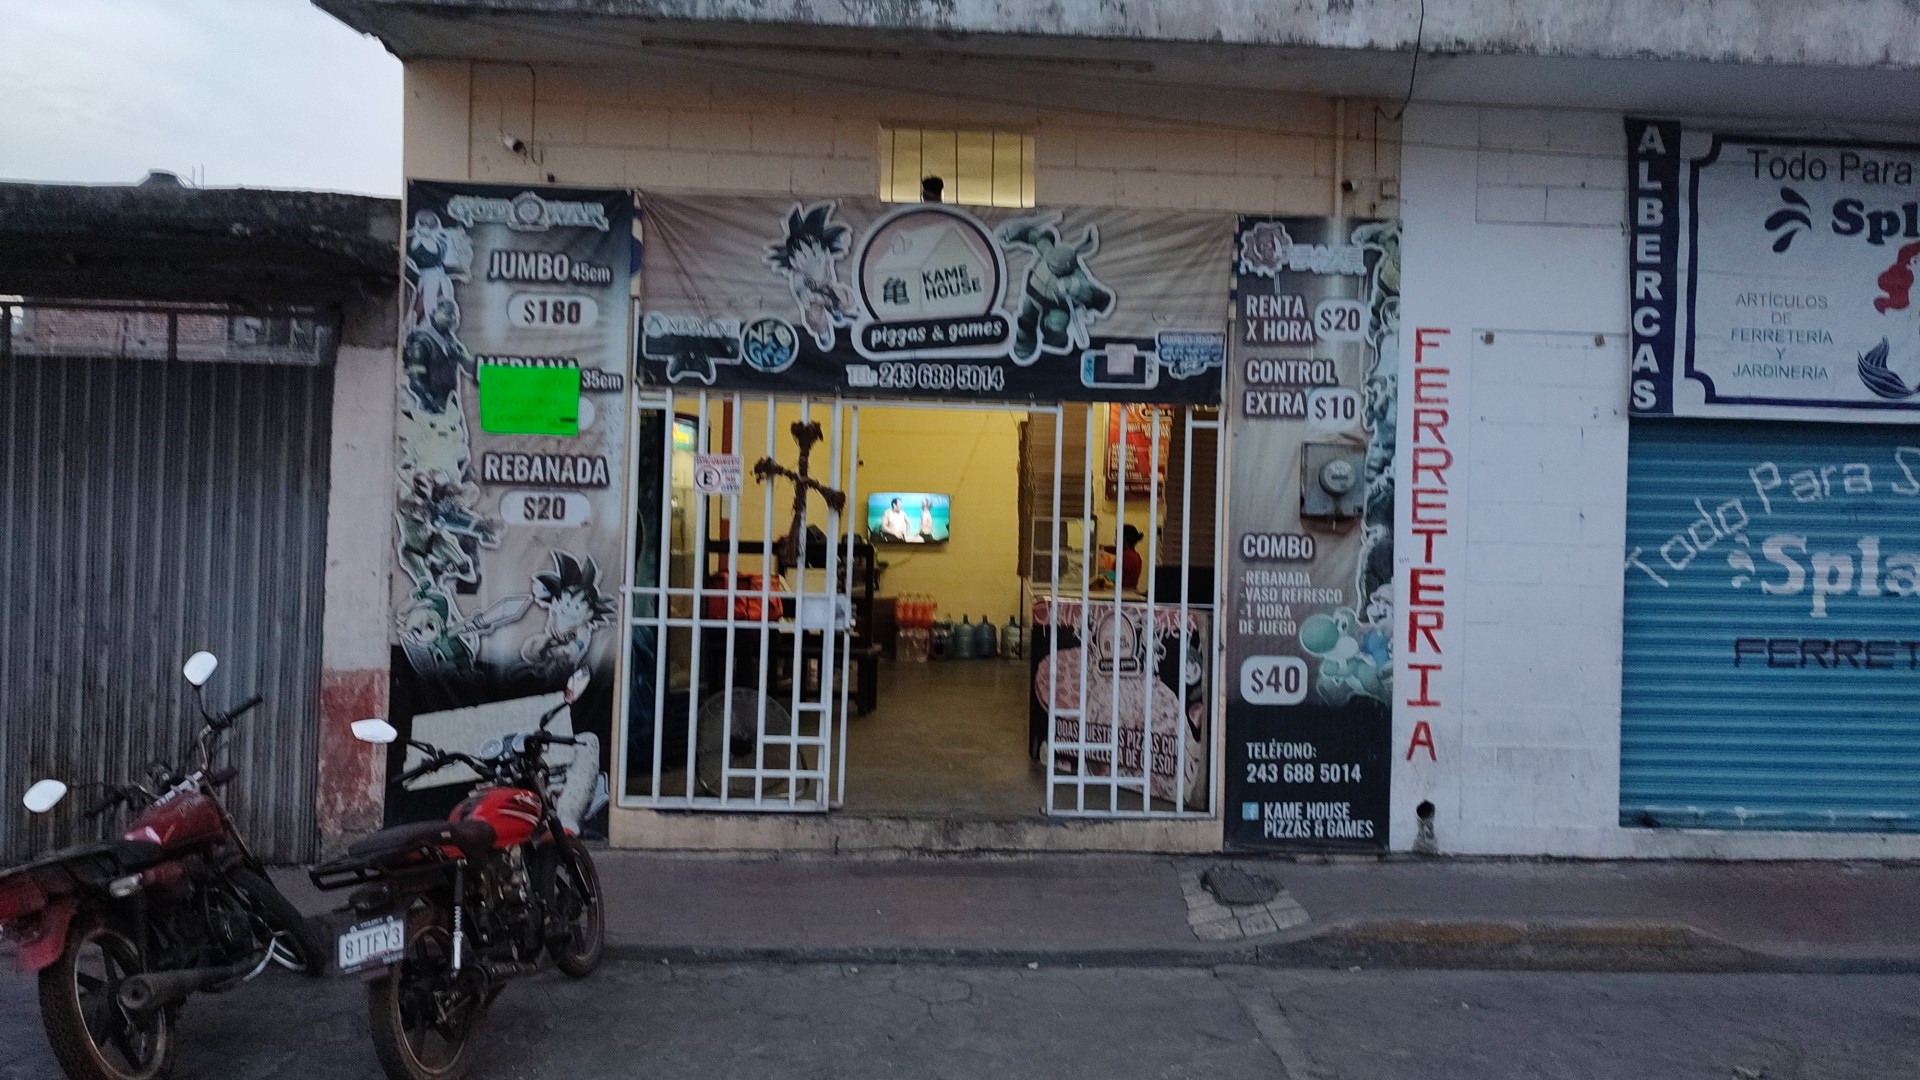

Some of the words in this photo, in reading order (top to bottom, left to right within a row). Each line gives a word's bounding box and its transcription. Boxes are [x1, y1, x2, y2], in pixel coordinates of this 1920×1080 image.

[1747, 148, 1828, 181] Todo
[1840, 151, 1912, 186] Para
[1831, 198, 1920, 246] Spl
[489, 250, 570, 282] JUMBO
[570, 265, 612, 283] 45cm
[922, 264, 968, 286] KAME
[1631, 124, 1666, 410] ALBERCAS
[924, 278, 982, 301] HOUSE
[1735, 291, 1829, 310] ARTÍCULOS
[523, 299, 582, 325] $180
[1246, 294, 1306, 319] RENTA
[1771, 311, 1792, 325] DE
[931, 324, 945, 342] &
[948, 320, 1003, 343] games
[1246, 320, 1258, 342] X
[1263, 320, 1315, 343] HORA
[1320, 306, 1361, 333] $20
[1731, 327, 1834, 346] FERRETERÍA
[1776, 347, 1786, 361] Y
[581, 370, 623, 390] 35cm
[879, 362, 916, 389] 243
[918, 363, 954, 389] 688
[957, 364, 1004, 391] 5014
[1246, 358, 1336, 385] CONTROL
[1732, 362, 1830, 381] JARDINERÍA
[1245, 391, 1306, 416] EXTRA
[1314, 394, 1356, 421] $10
[483, 453, 609, 486] REBANADA
[523, 496, 566, 521] $20
[1624, 498, 1749, 588] Todo
[1749, 461, 1873, 516] Para
[1242, 534, 1314, 560] COMBO
[1406, 327, 1454, 762] FERRETERIA
[1760, 534, 1920, 618] Spla
[1281, 587, 1343, 604] REFRESCO
[1256, 604, 1292, 620] HORA
[1238, 619, 1256, 636] DE
[1257, 620, 1298, 637] JUEGO
[1251, 665, 1300, 696] $40
[1246, 738, 1318, 760] TELÉFONO:
[1246, 764, 1279, 784] 243
[1283, 764, 1315, 784] 688
[1319, 764, 1362, 784] 5014
[1264, 802, 1303, 820] KAME
[1306, 802, 1351, 820] HOUSE
[1264, 820, 1312, 839] PIZZAS
[1314, 820, 1324, 838] &
[1326, 820, 1375, 839] GAMES
